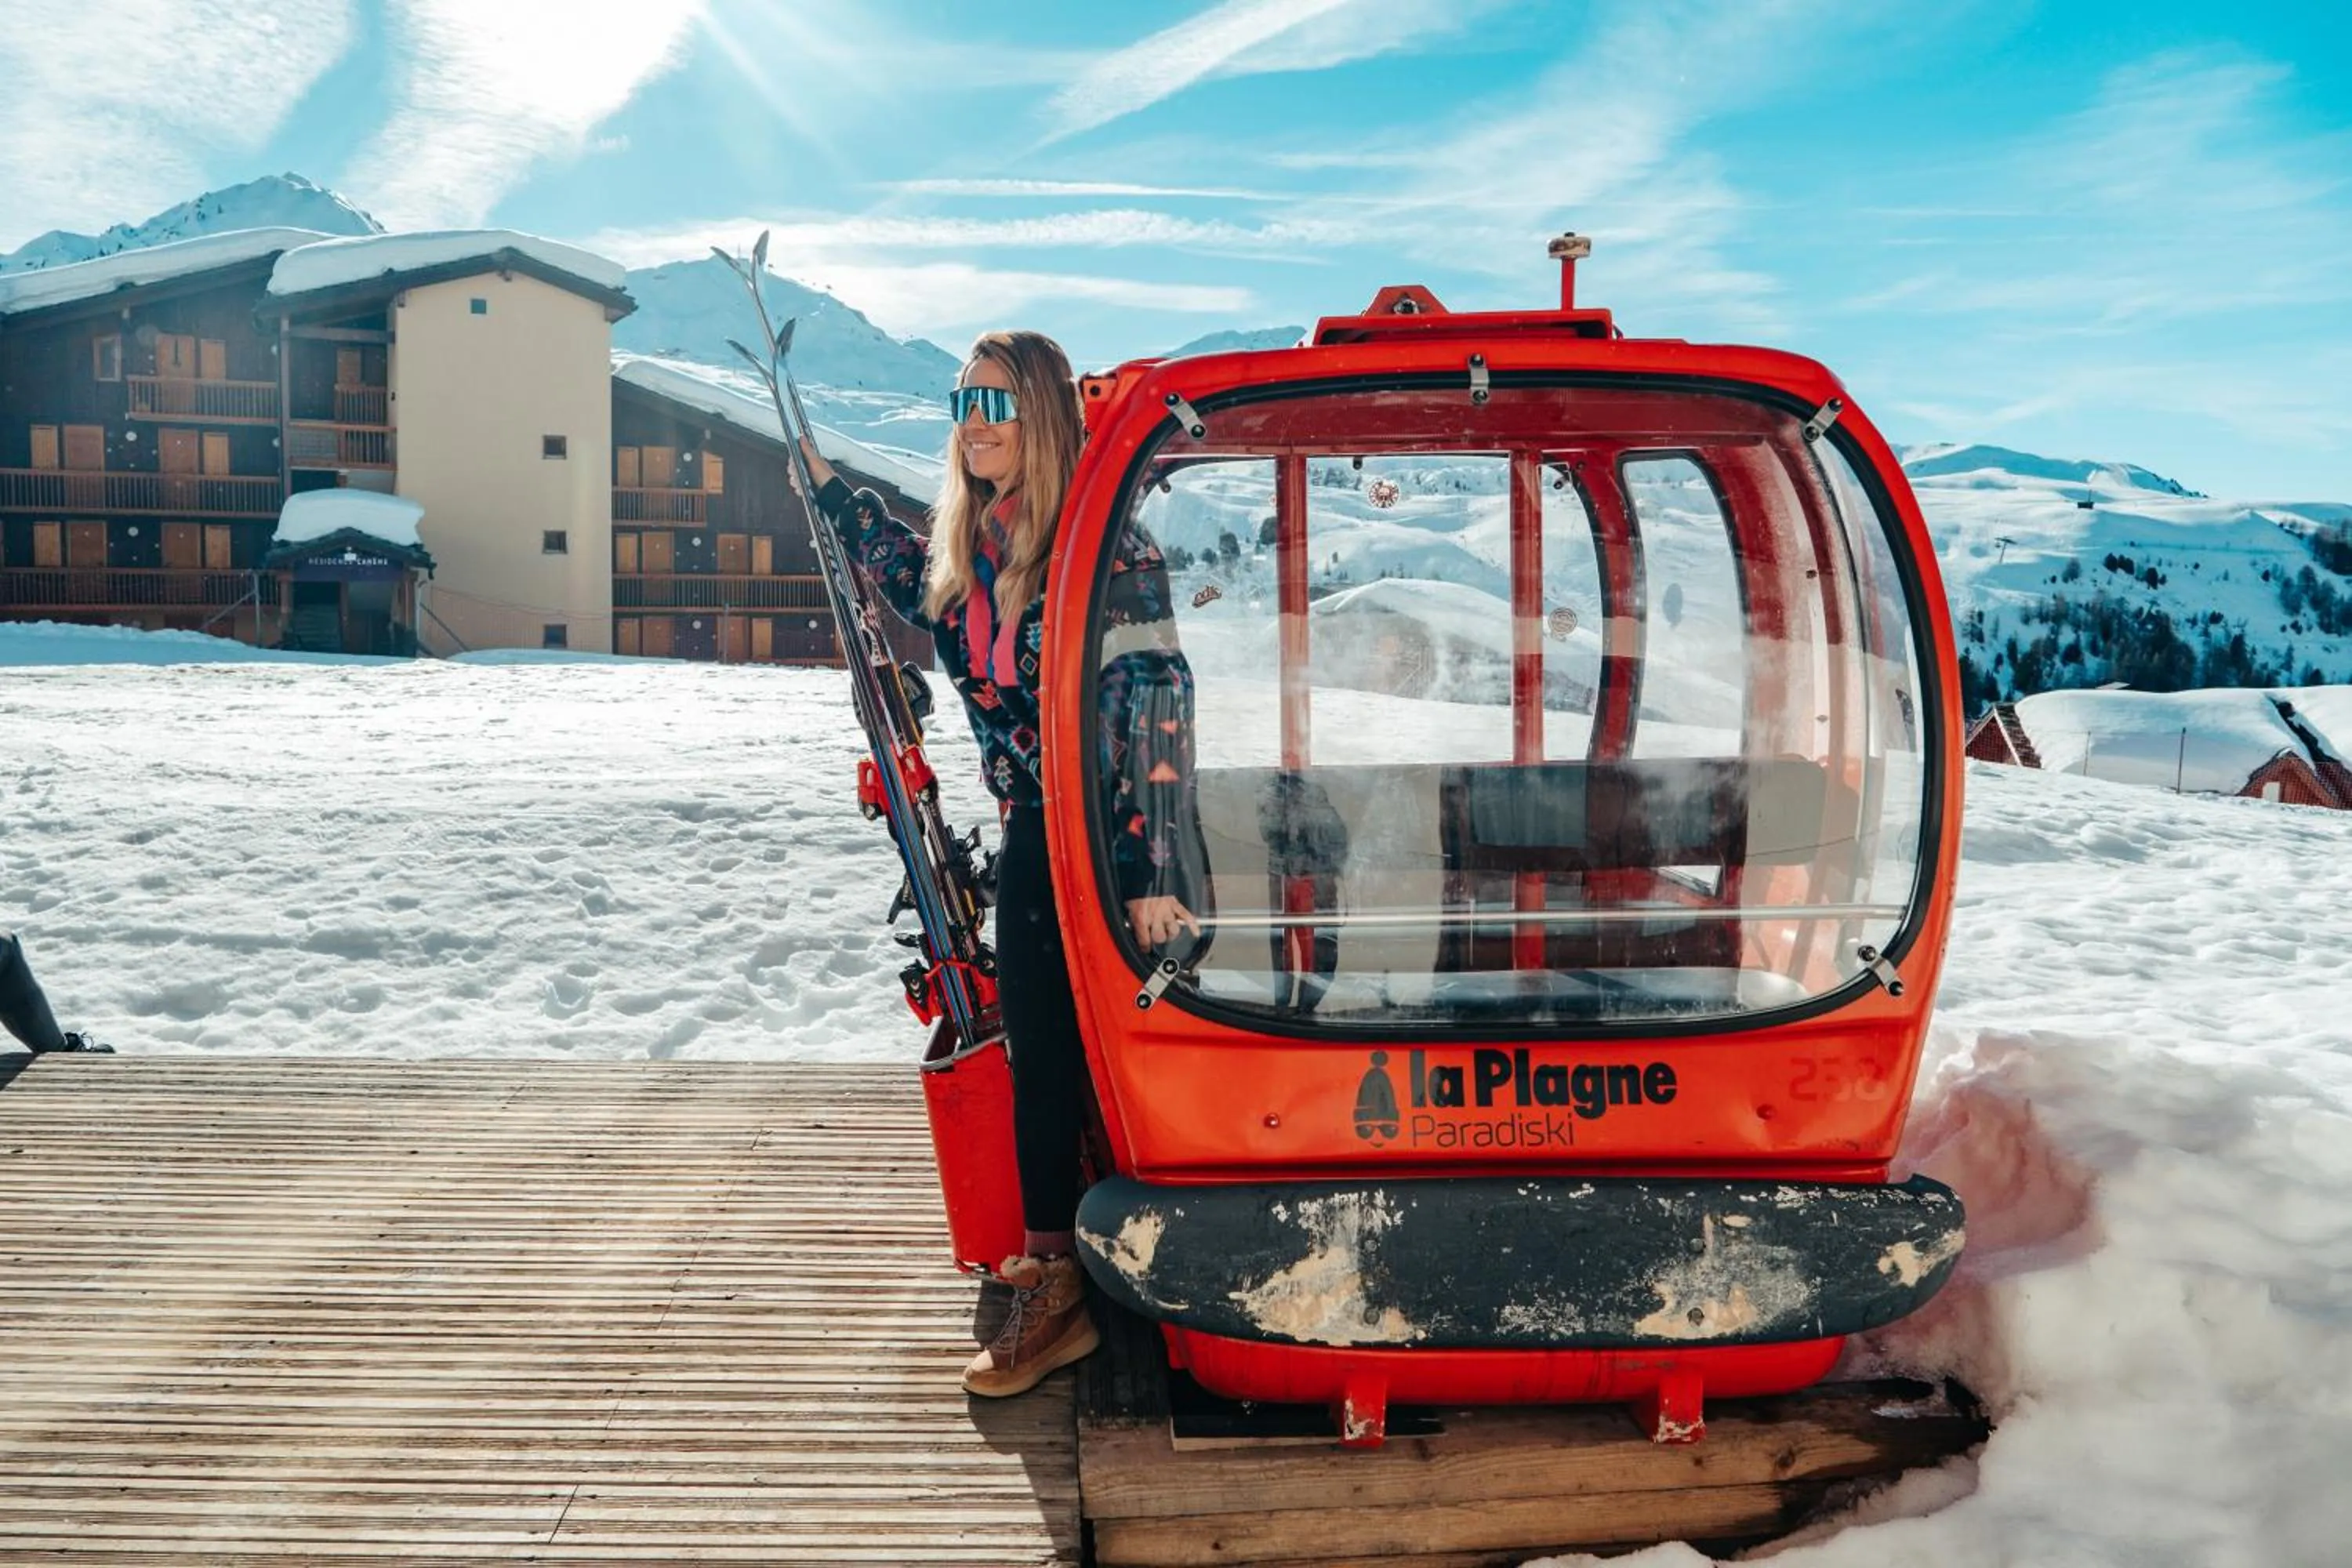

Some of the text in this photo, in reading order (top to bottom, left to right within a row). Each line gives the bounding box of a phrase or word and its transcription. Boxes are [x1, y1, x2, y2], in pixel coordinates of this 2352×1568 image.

[1410, 1048, 1678, 1120] la Plagne
[1411, 1112, 1575, 1148] Paradiski
